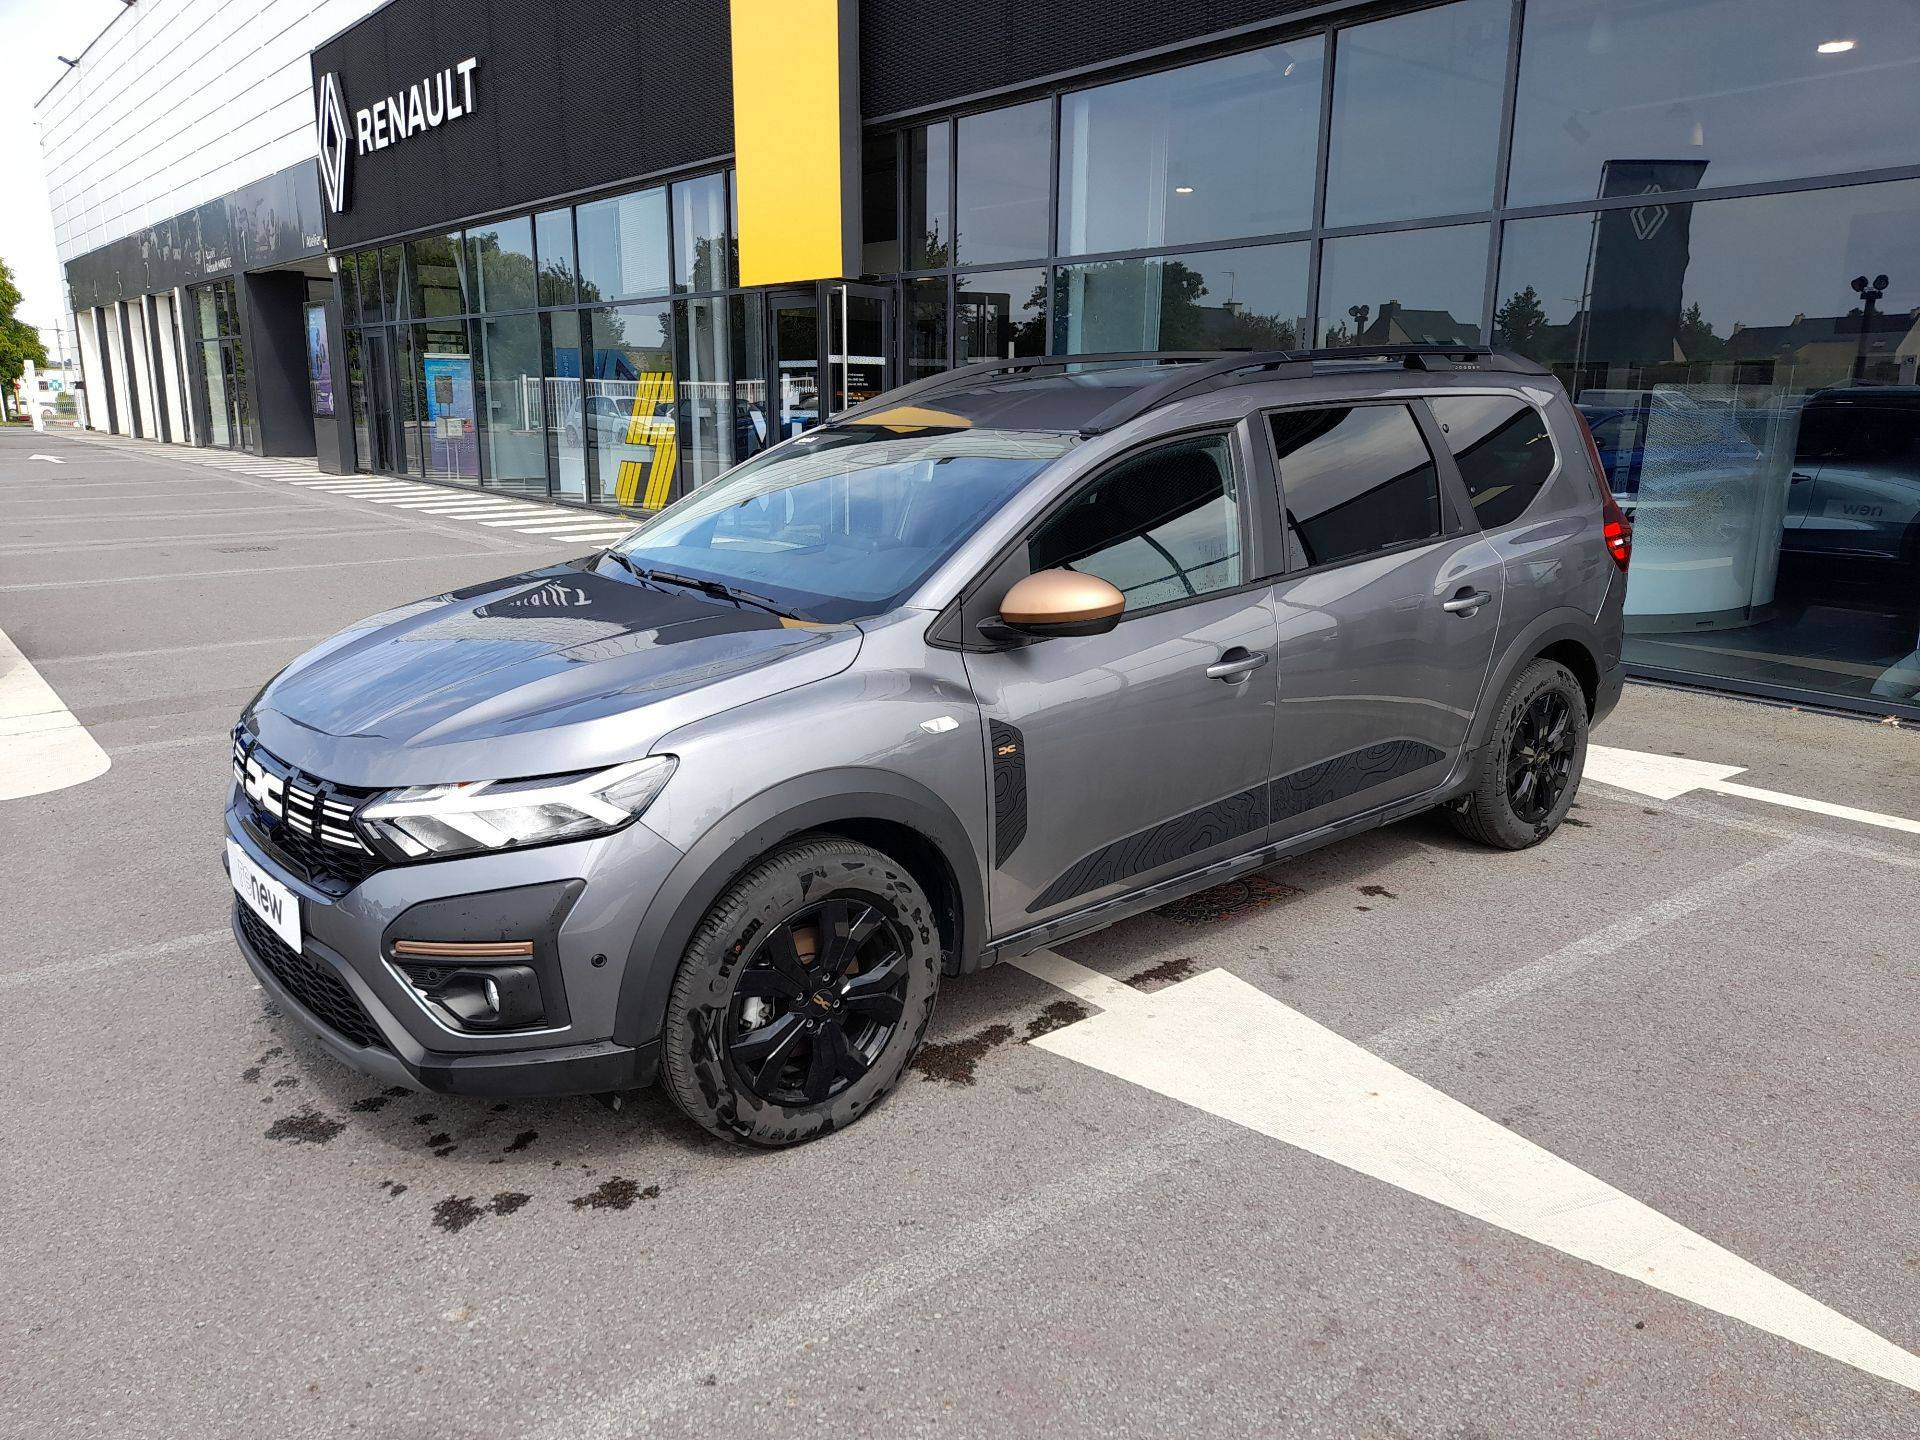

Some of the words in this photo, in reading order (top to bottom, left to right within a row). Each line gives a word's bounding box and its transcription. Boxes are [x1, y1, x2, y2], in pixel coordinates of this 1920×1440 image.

[356, 57, 477, 155] RENAULT
[115, 270, 123, 297] 3
[143, 261, 151, 289] 2
[790, 385, 818, 393] Bienvenue
